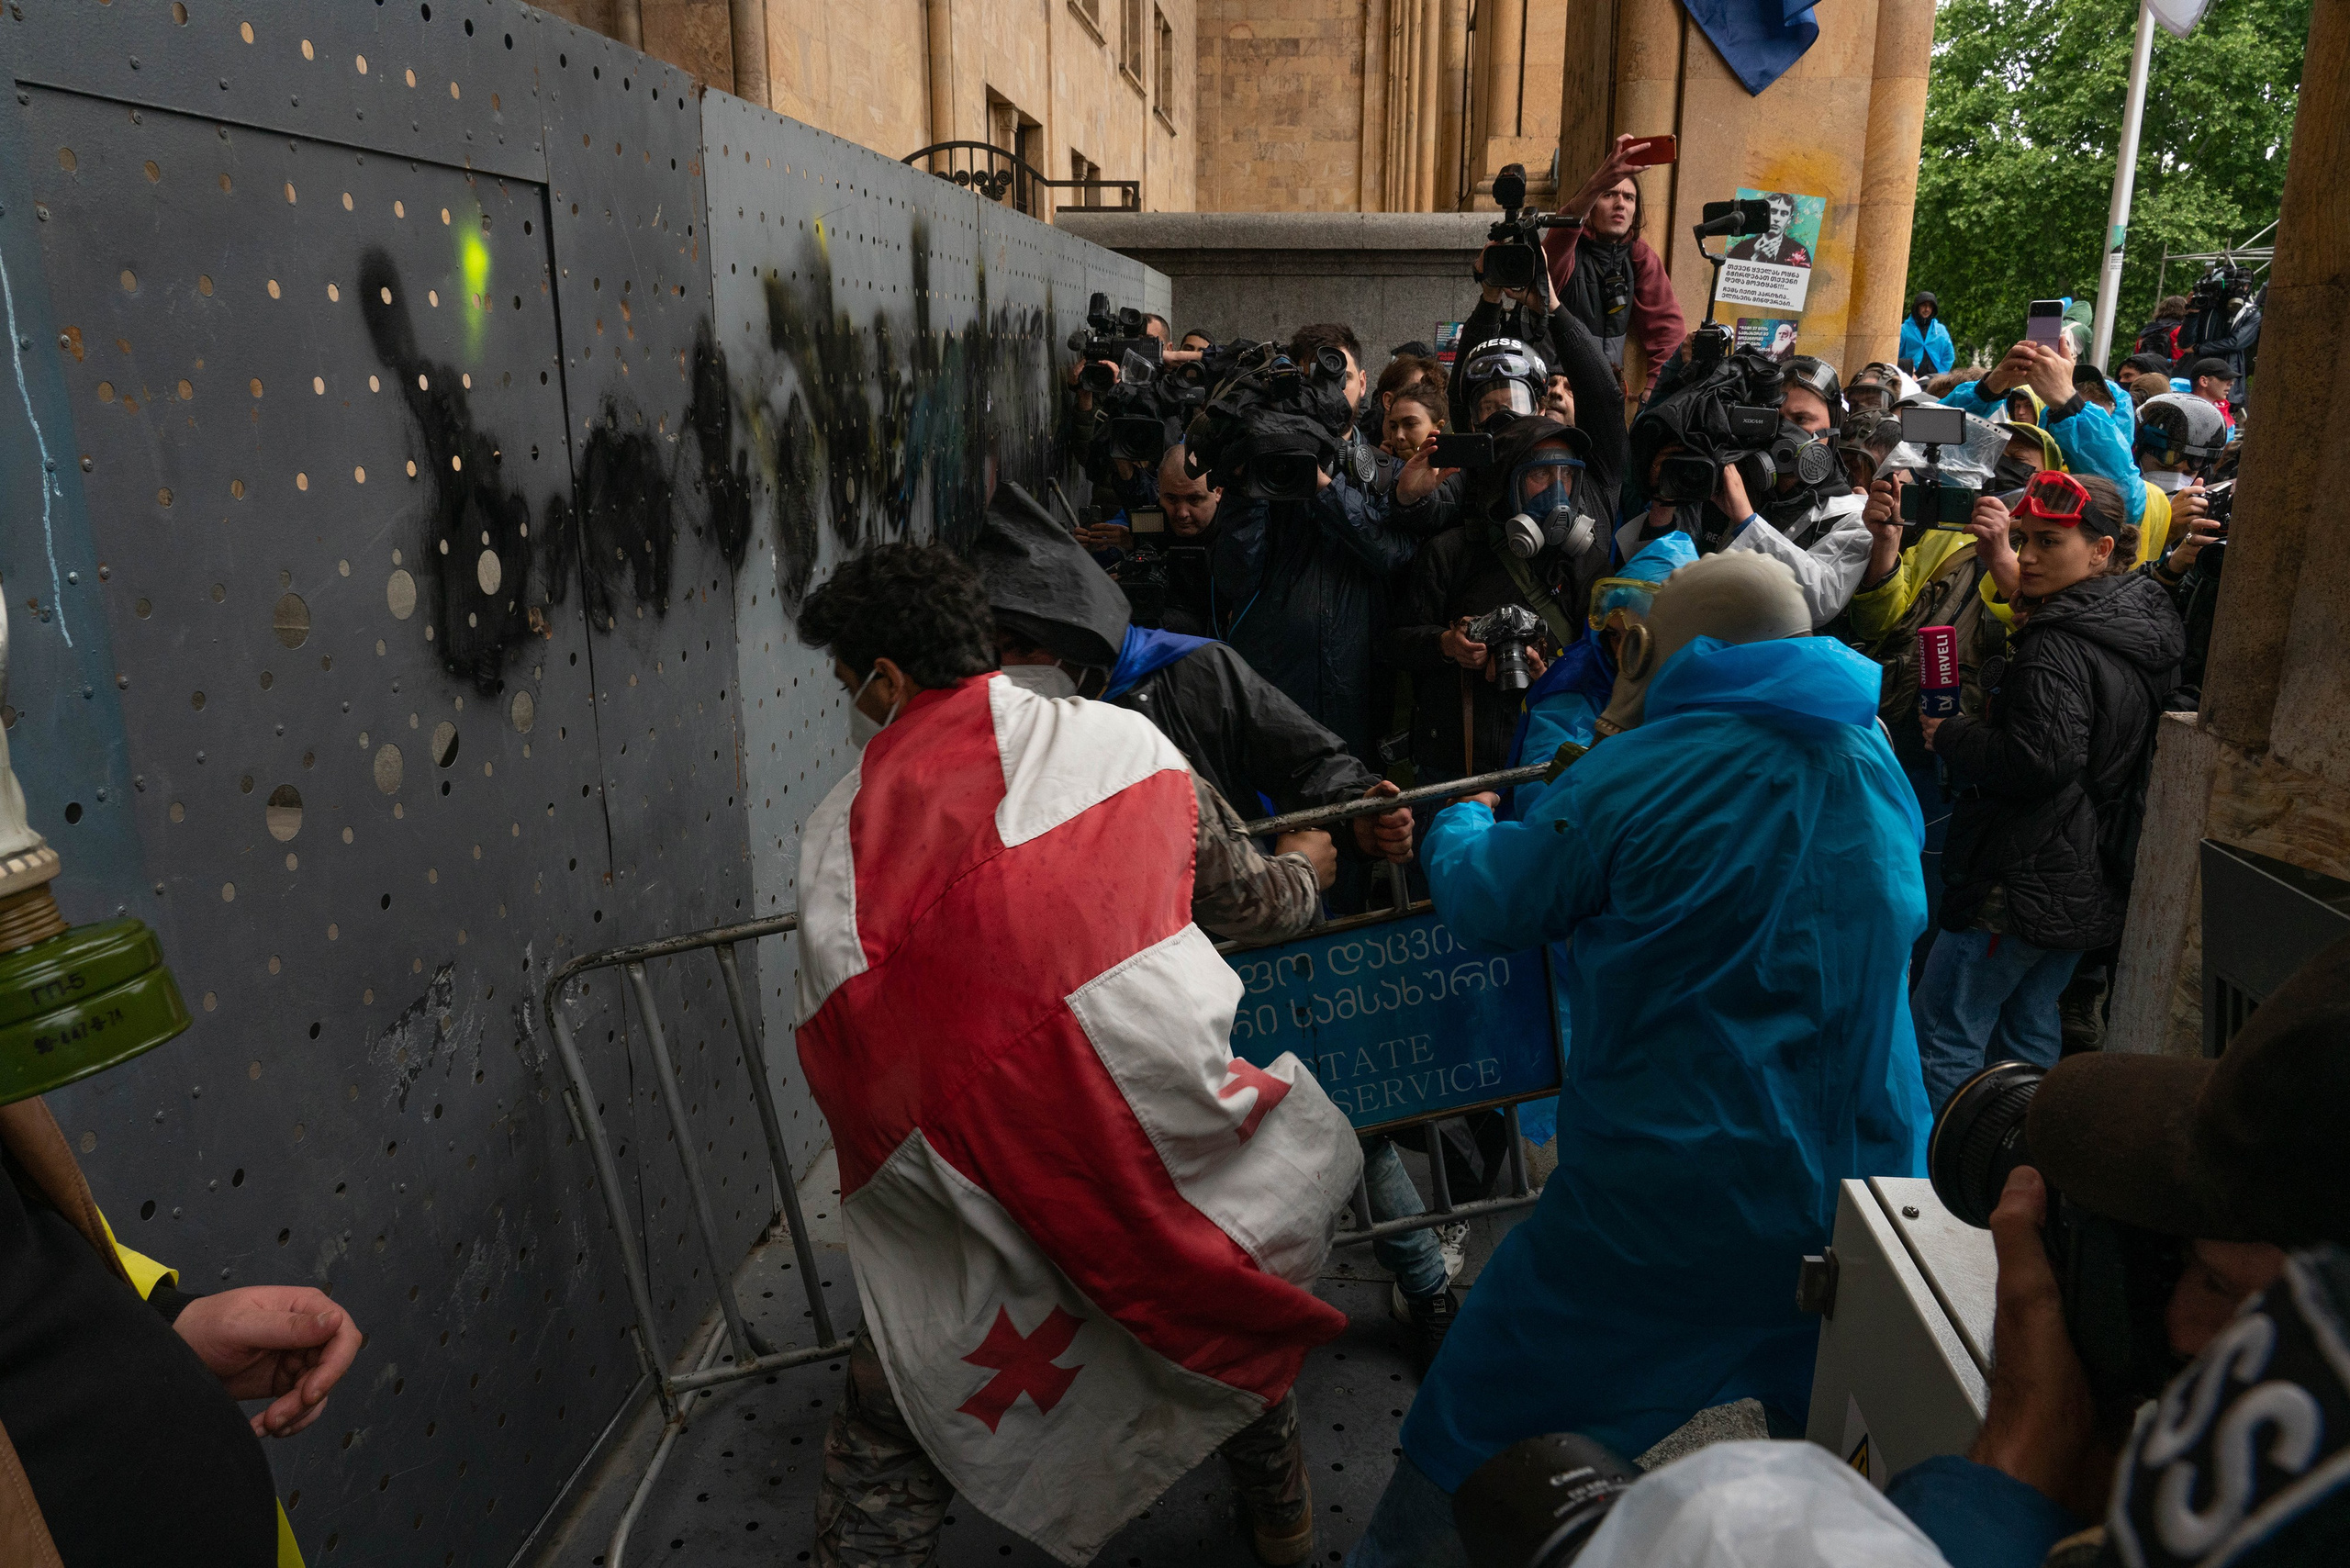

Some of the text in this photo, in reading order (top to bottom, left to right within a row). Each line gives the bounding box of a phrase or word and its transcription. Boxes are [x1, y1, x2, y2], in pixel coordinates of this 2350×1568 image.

[1469, 337, 1522, 359] PRESS
[1936, 634, 1953, 685] PIRVELI
[1289, 957, 1510, 1029] სამსახური
[1330, 1057, 1503, 1116] SERVICE
